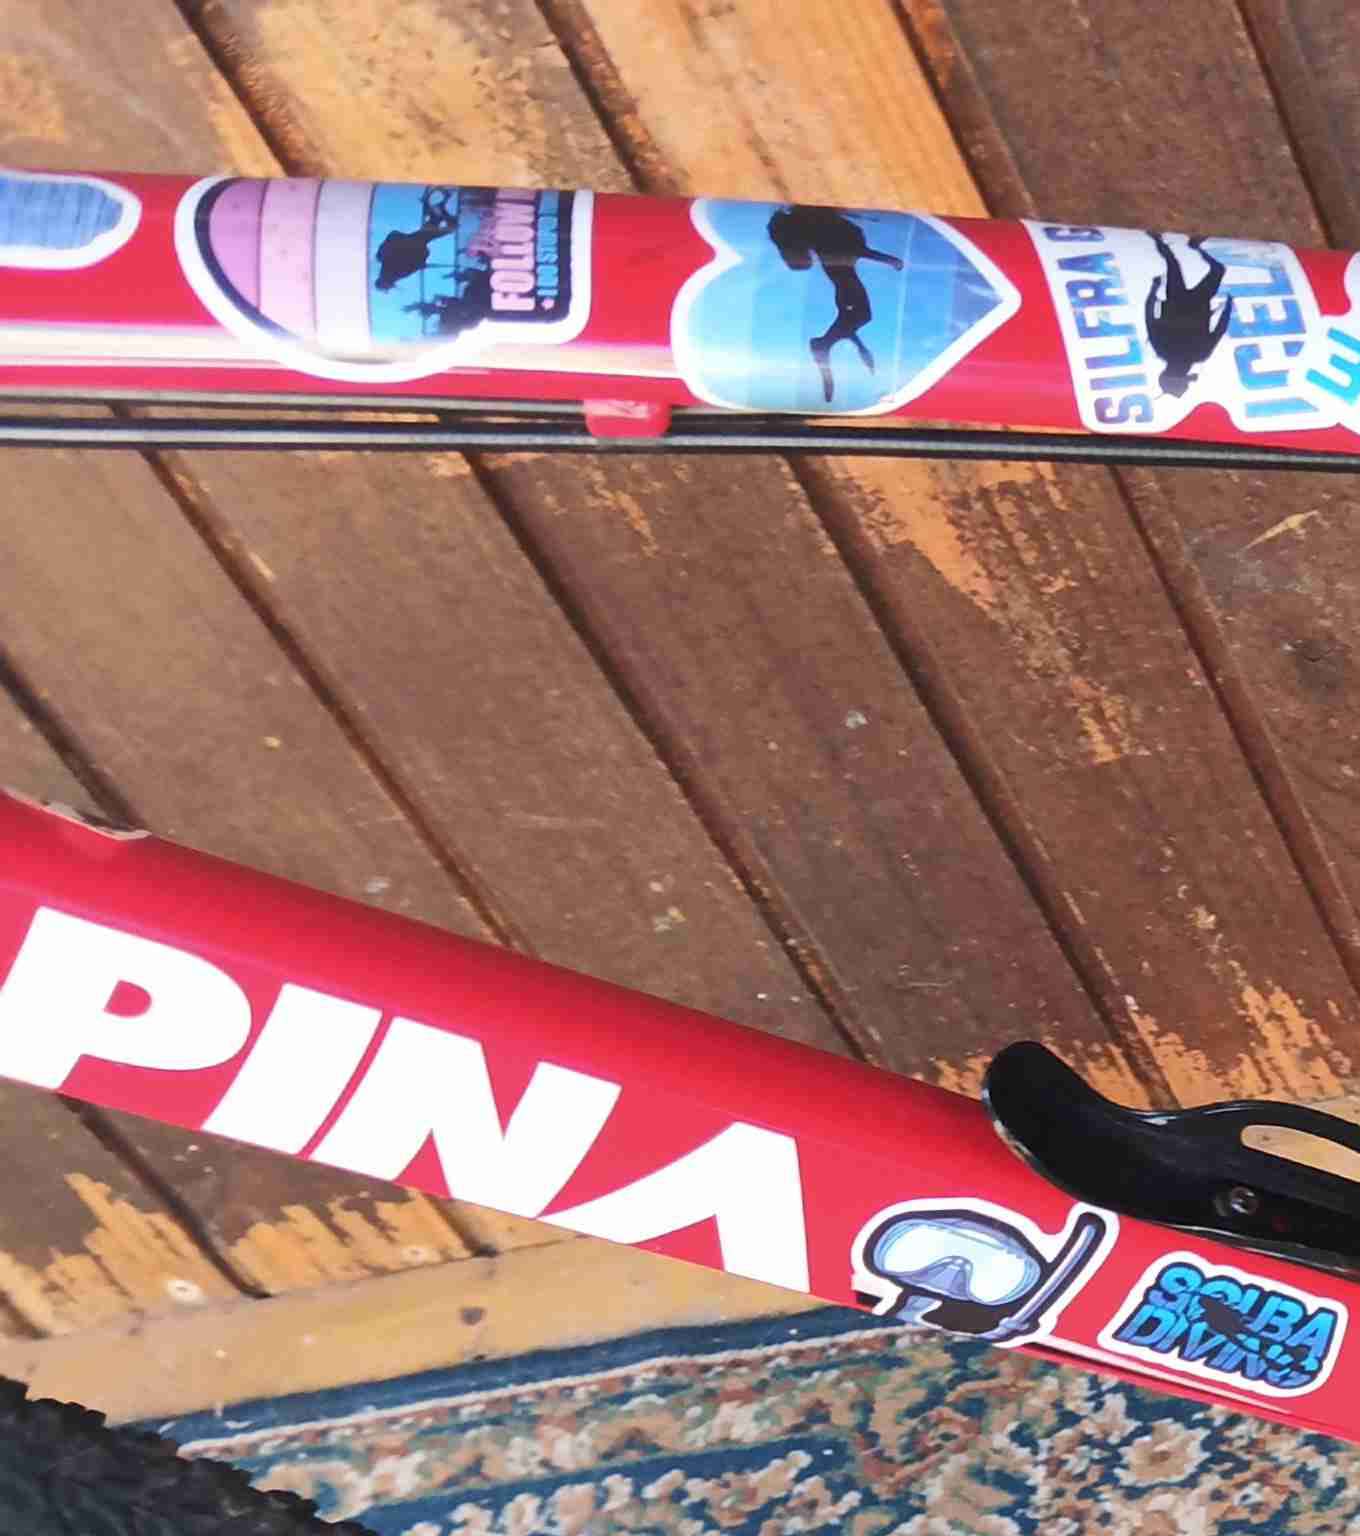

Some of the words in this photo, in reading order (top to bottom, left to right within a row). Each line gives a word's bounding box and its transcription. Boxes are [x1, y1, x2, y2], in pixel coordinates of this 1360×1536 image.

[489, 203, 536, 311] FOLLOW
[1057, 252, 1154, 424] SILFRA
[1147, 1264, 1338, 1364] SCUBA
